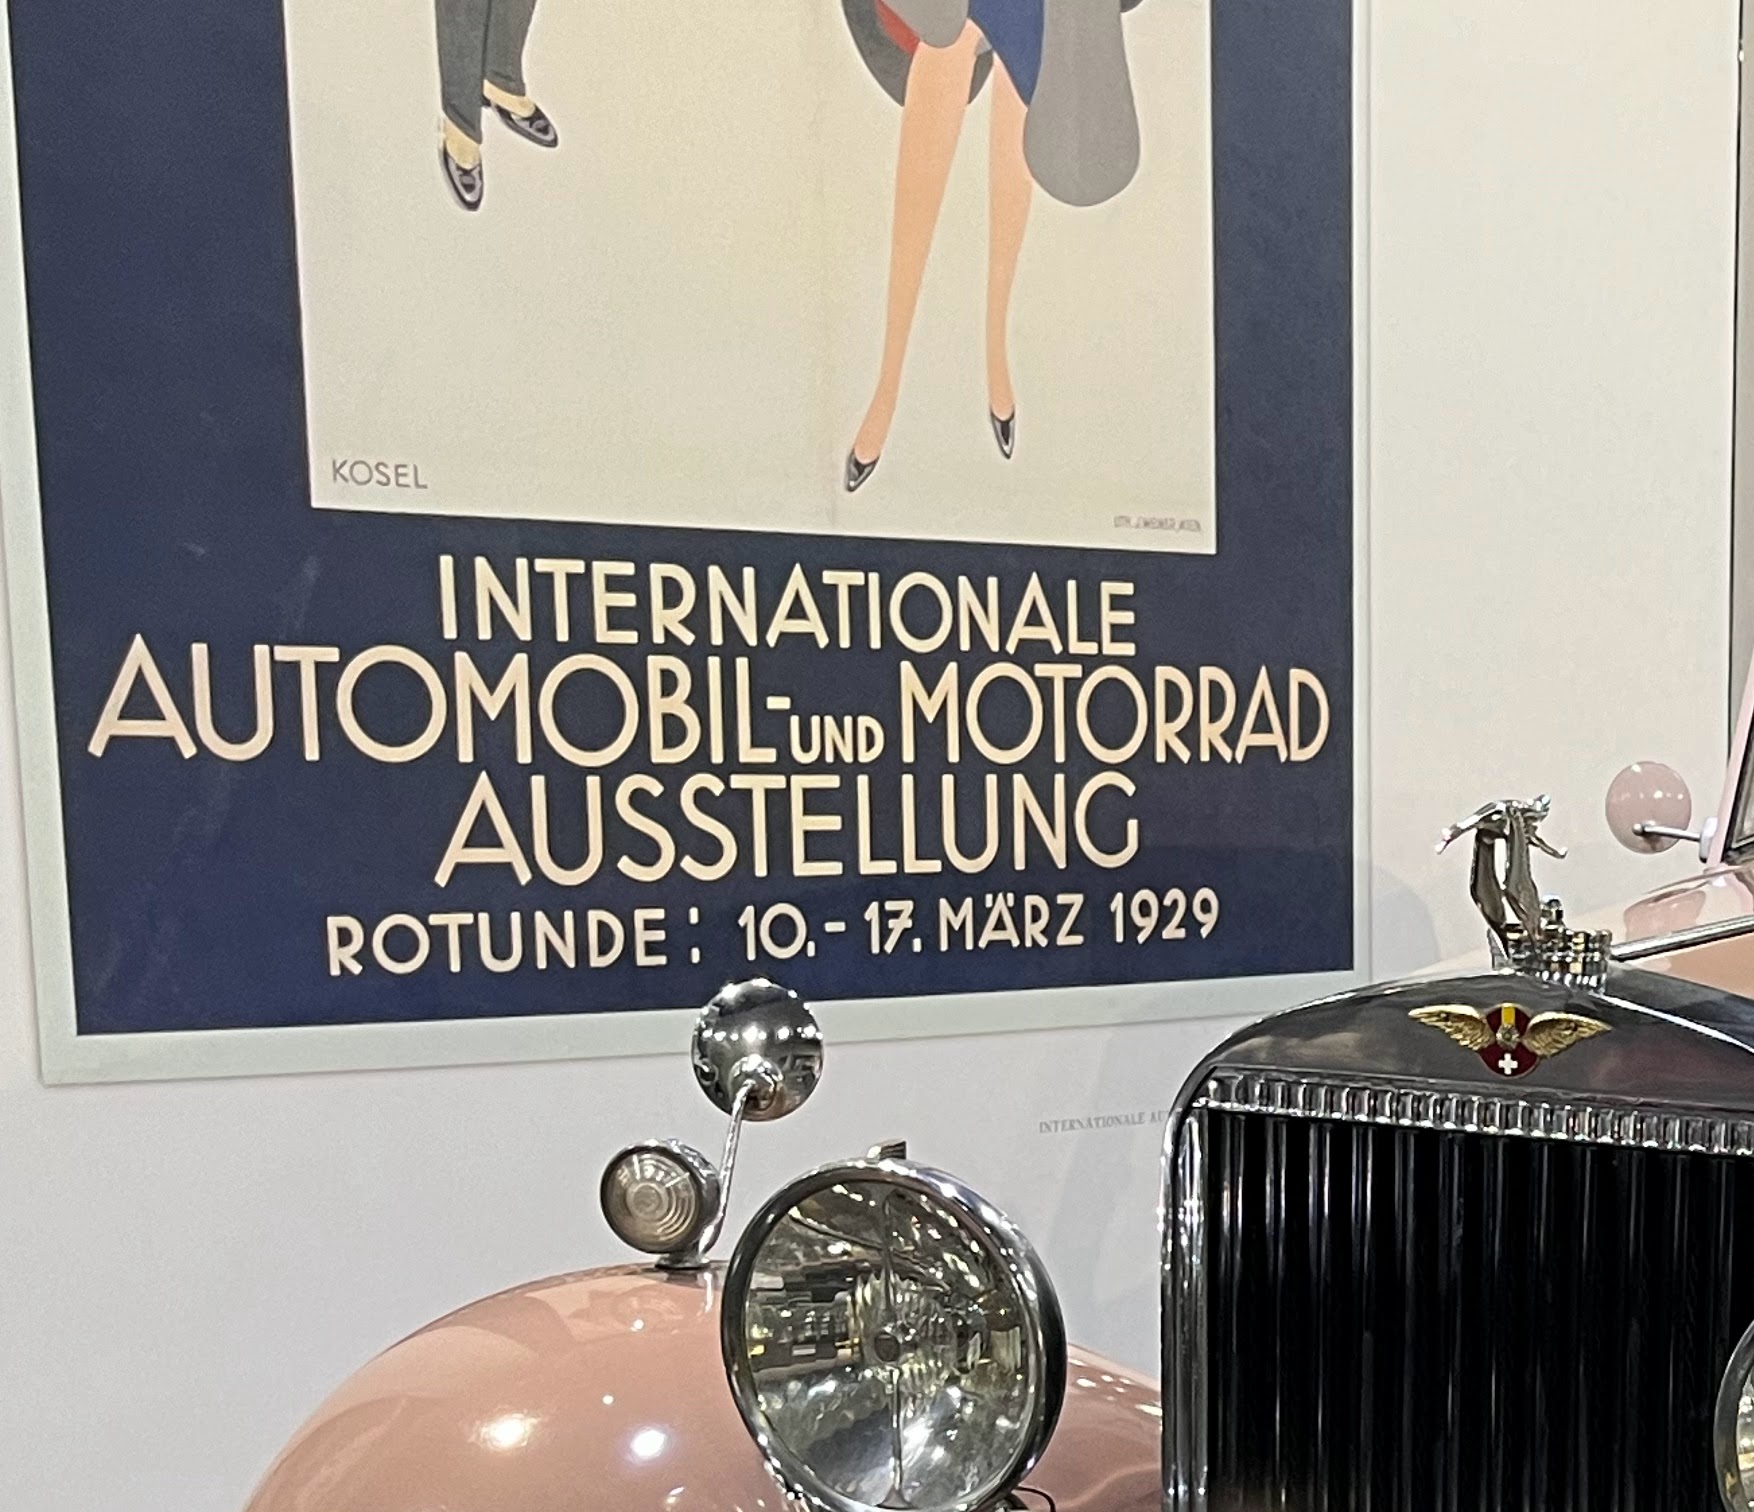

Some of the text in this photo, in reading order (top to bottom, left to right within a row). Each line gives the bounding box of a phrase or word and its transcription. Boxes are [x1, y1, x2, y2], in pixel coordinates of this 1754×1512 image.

[332, 458, 428, 490] KOSEL
[439, 554, 1136, 657] INTERNATIONALE
[900, 660, 1331, 766] MOTORRAD
[434, 769, 1140, 888] AUSSTELLUNG
[938, 891, 1084, 952] MÄRZ
[1110, 886, 1220, 946] 1929
[1039, 1111, 1145, 1134] INTERNATIONALE
